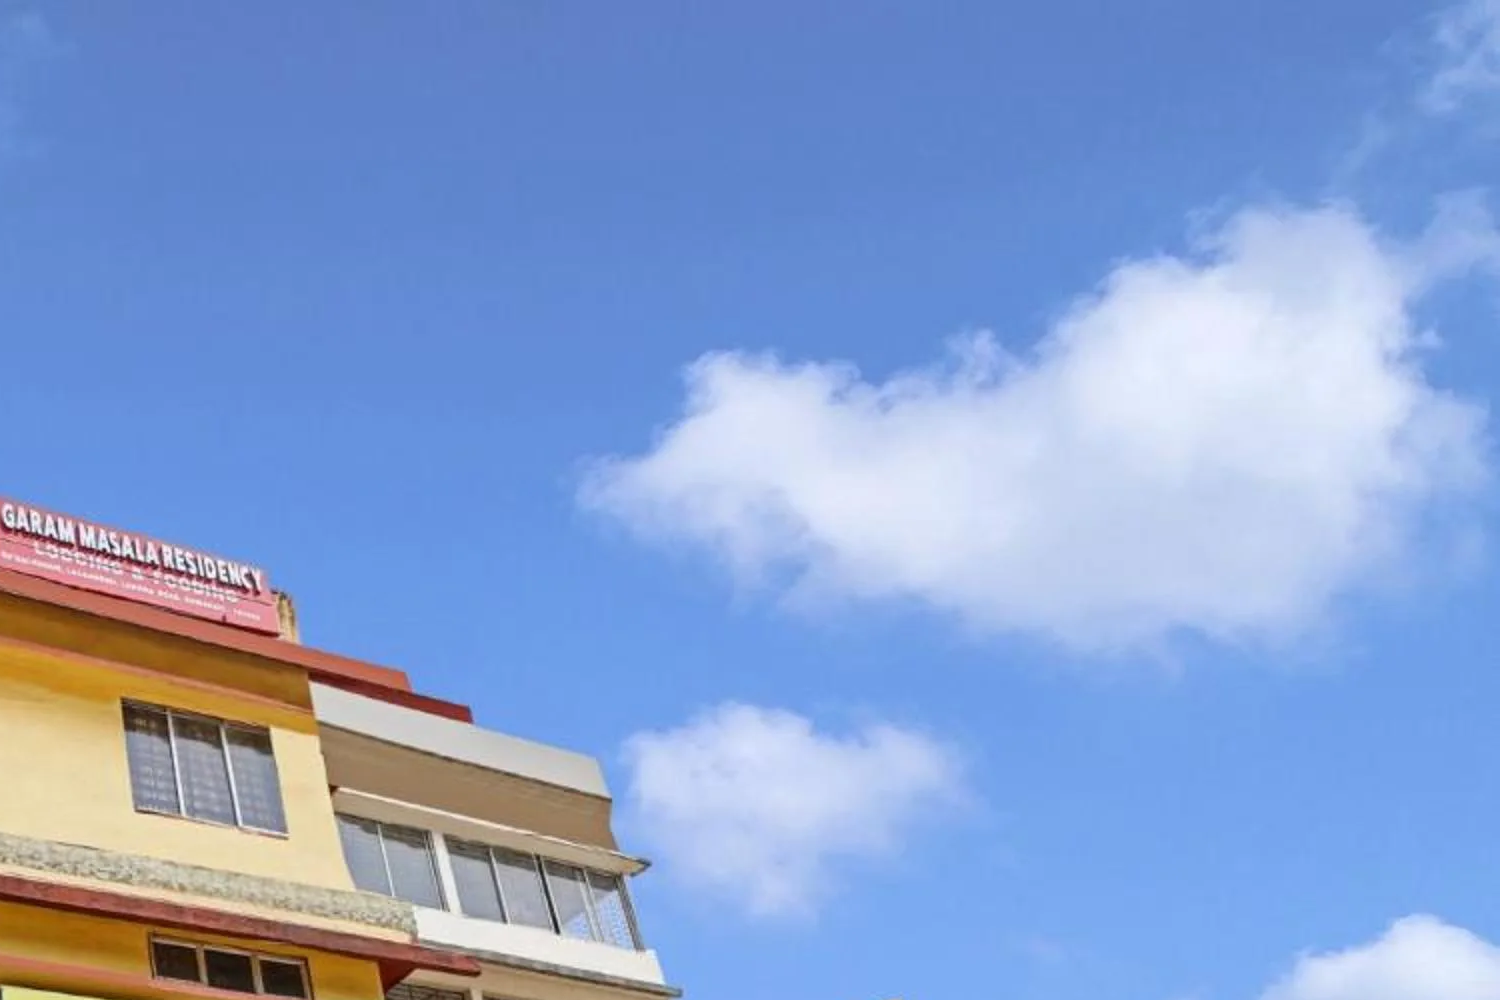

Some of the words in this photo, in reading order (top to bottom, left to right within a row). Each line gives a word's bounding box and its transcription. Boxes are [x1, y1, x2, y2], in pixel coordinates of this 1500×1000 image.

[0, 502, 76, 545] GARAM
[77, 522, 160, 567] MASALA
[160, 543, 264, 593] RESIDENCY
